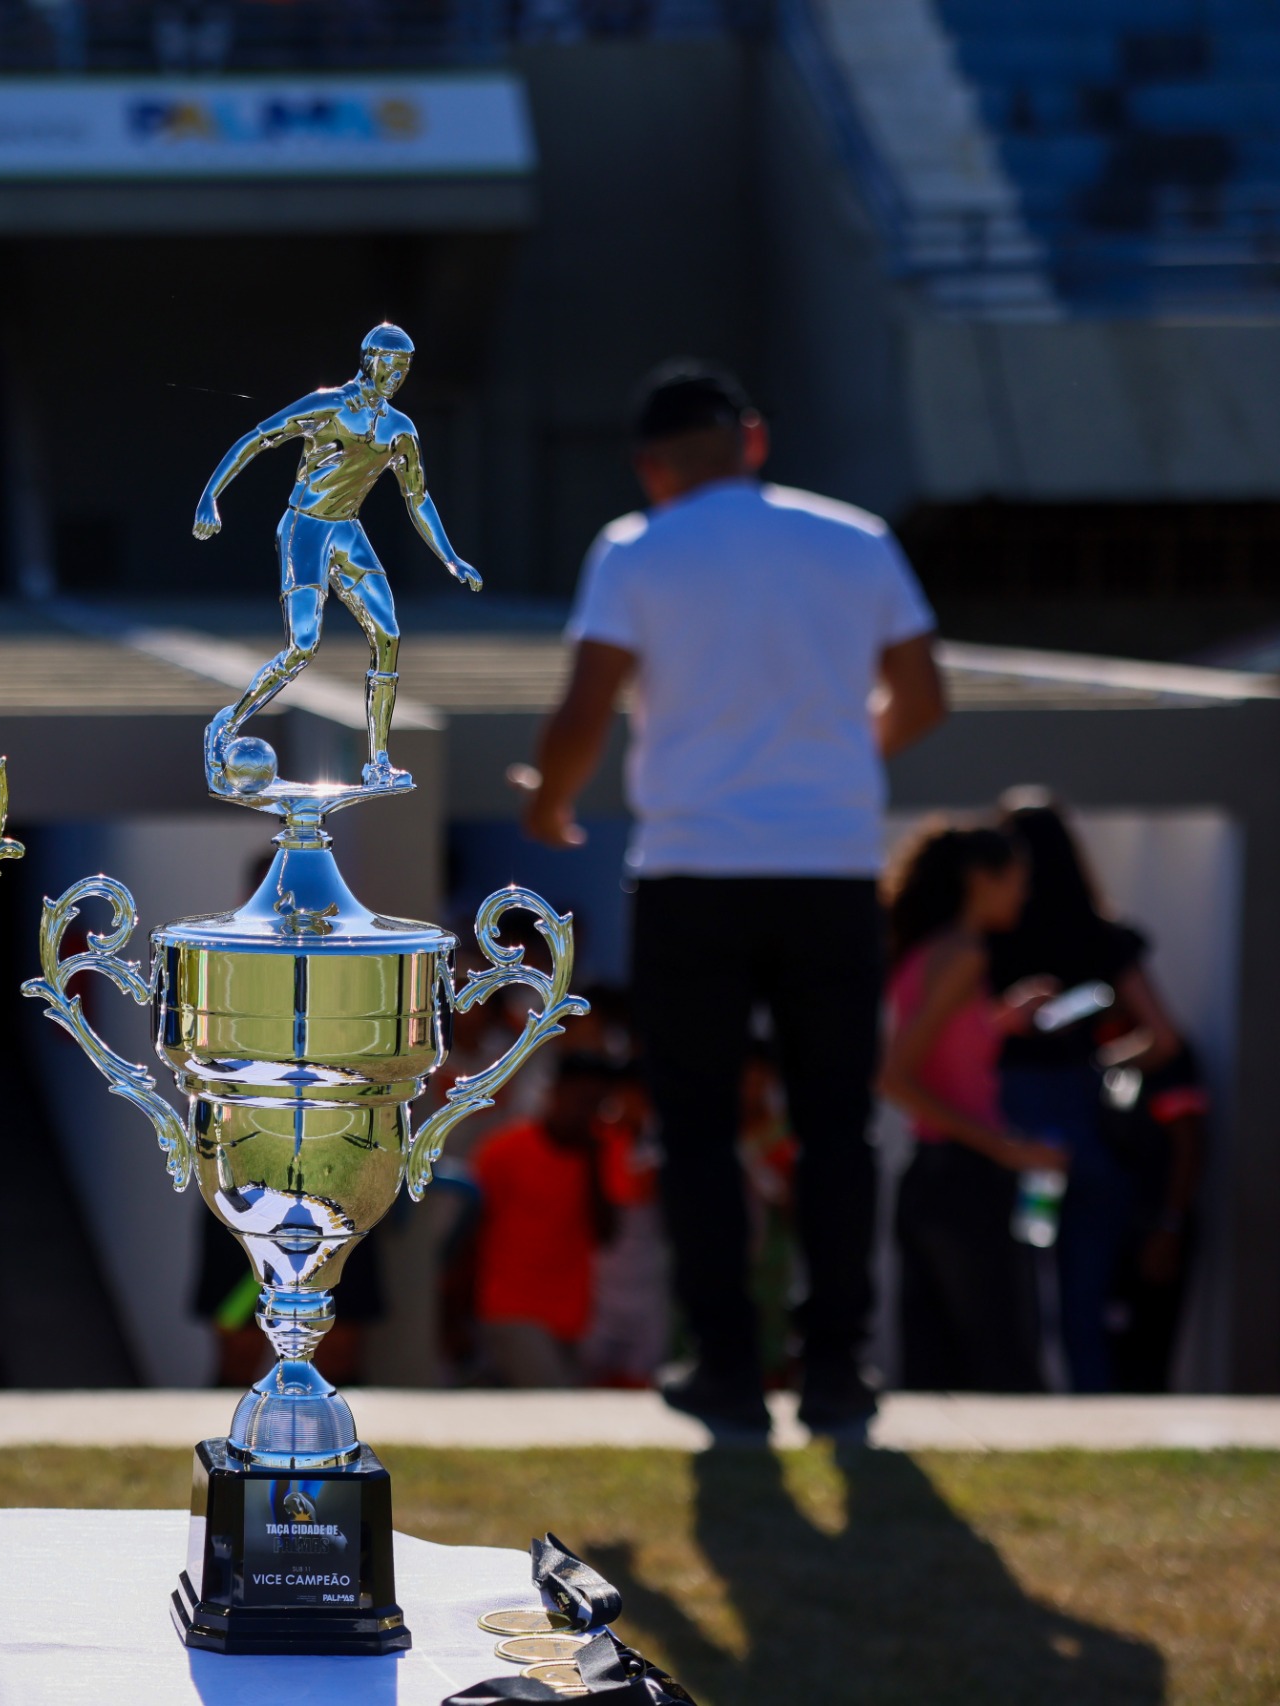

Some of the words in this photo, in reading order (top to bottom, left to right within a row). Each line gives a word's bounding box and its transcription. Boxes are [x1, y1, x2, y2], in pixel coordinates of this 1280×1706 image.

[128, 99, 424, 144] PALMAS
[266, 1524, 290, 1536] TAÇA
[291, 1524, 325, 1535] CIDADE
[326, 1525, 338, 1535] DE
[252, 1574, 282, 1585] VICE
[285, 1573, 350, 1586] CAMPEÃO
[322, 1594, 355, 1602] PALMAS
